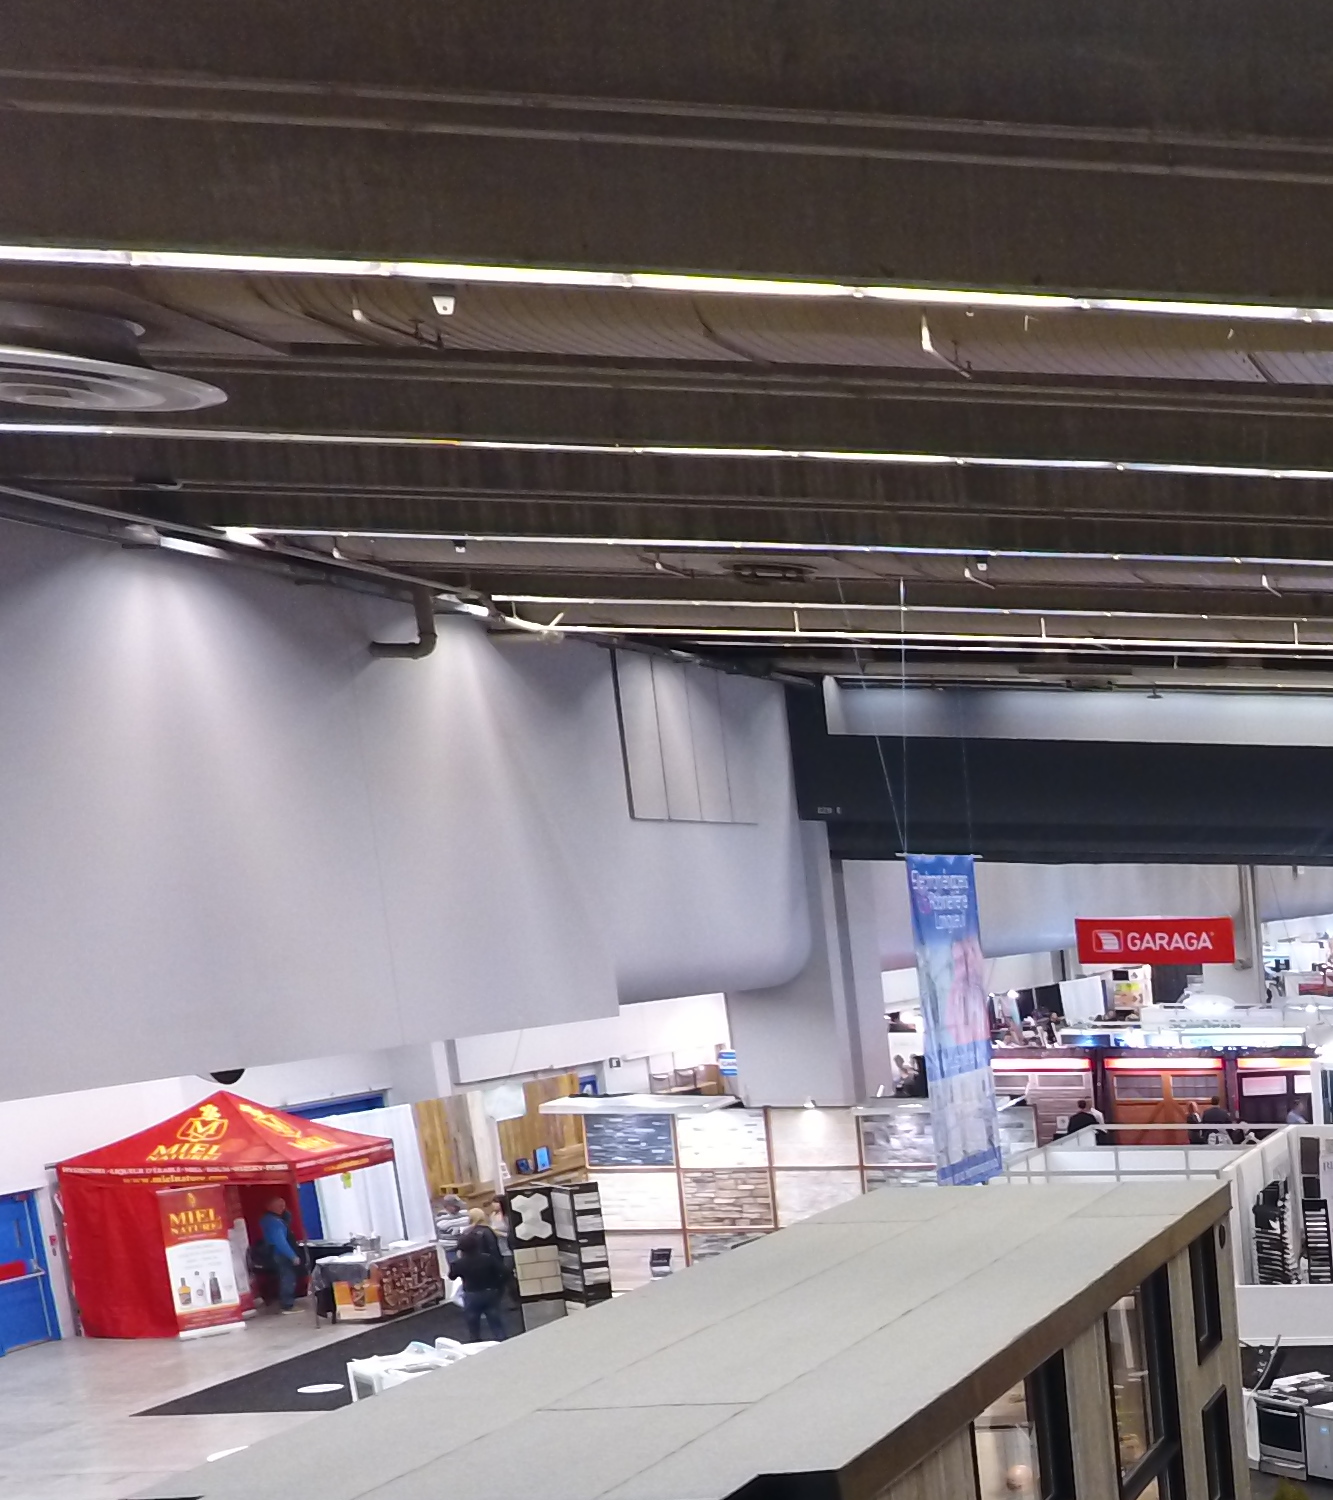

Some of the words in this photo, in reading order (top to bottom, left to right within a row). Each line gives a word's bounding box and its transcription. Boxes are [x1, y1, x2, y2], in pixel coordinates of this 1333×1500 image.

[1126, 932, 1213, 951] GARAGA
[150, 1143, 221, 1156] MIEL
[168, 1208, 219, 1227] MIEL
